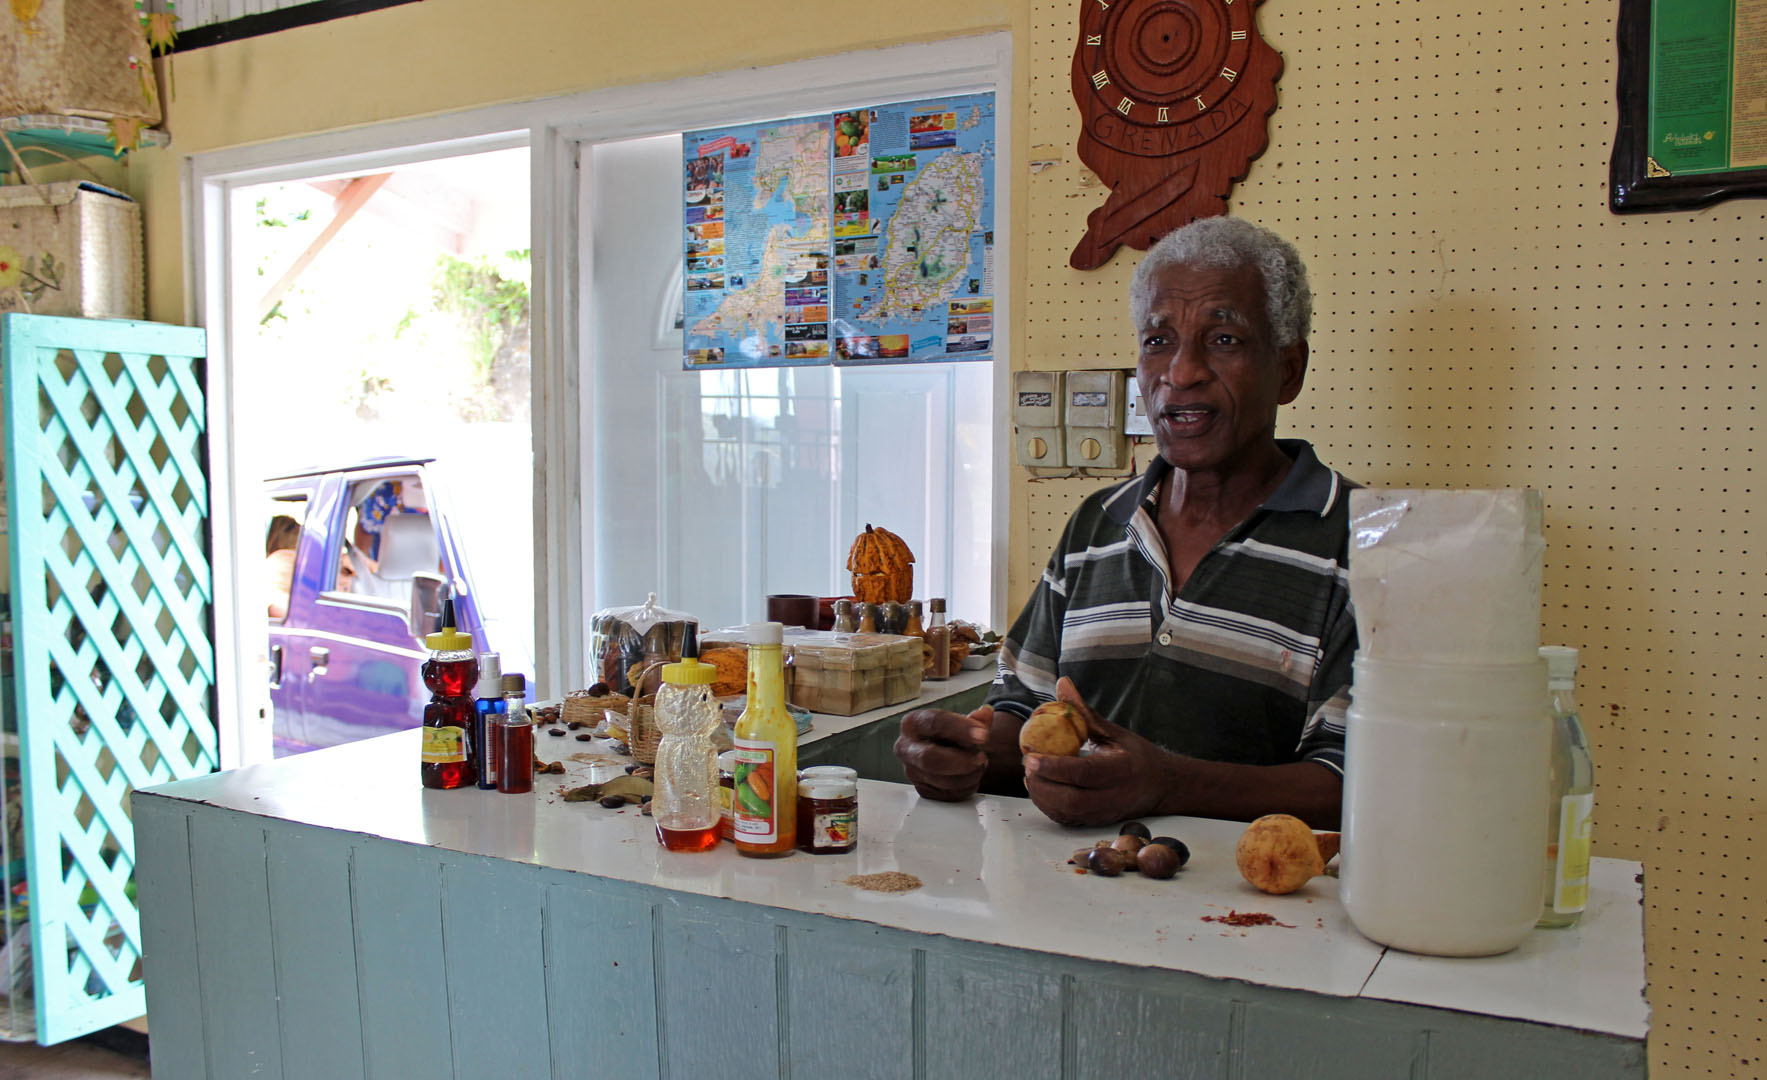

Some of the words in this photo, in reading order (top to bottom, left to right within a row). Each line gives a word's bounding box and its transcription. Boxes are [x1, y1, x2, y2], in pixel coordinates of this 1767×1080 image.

[1086, 34, 1101, 45] IX
[1231, 30, 1246, 41] III
[1157, 106, 1169, 122] VI
[1095, 98, 1247, 150] GRENADA
